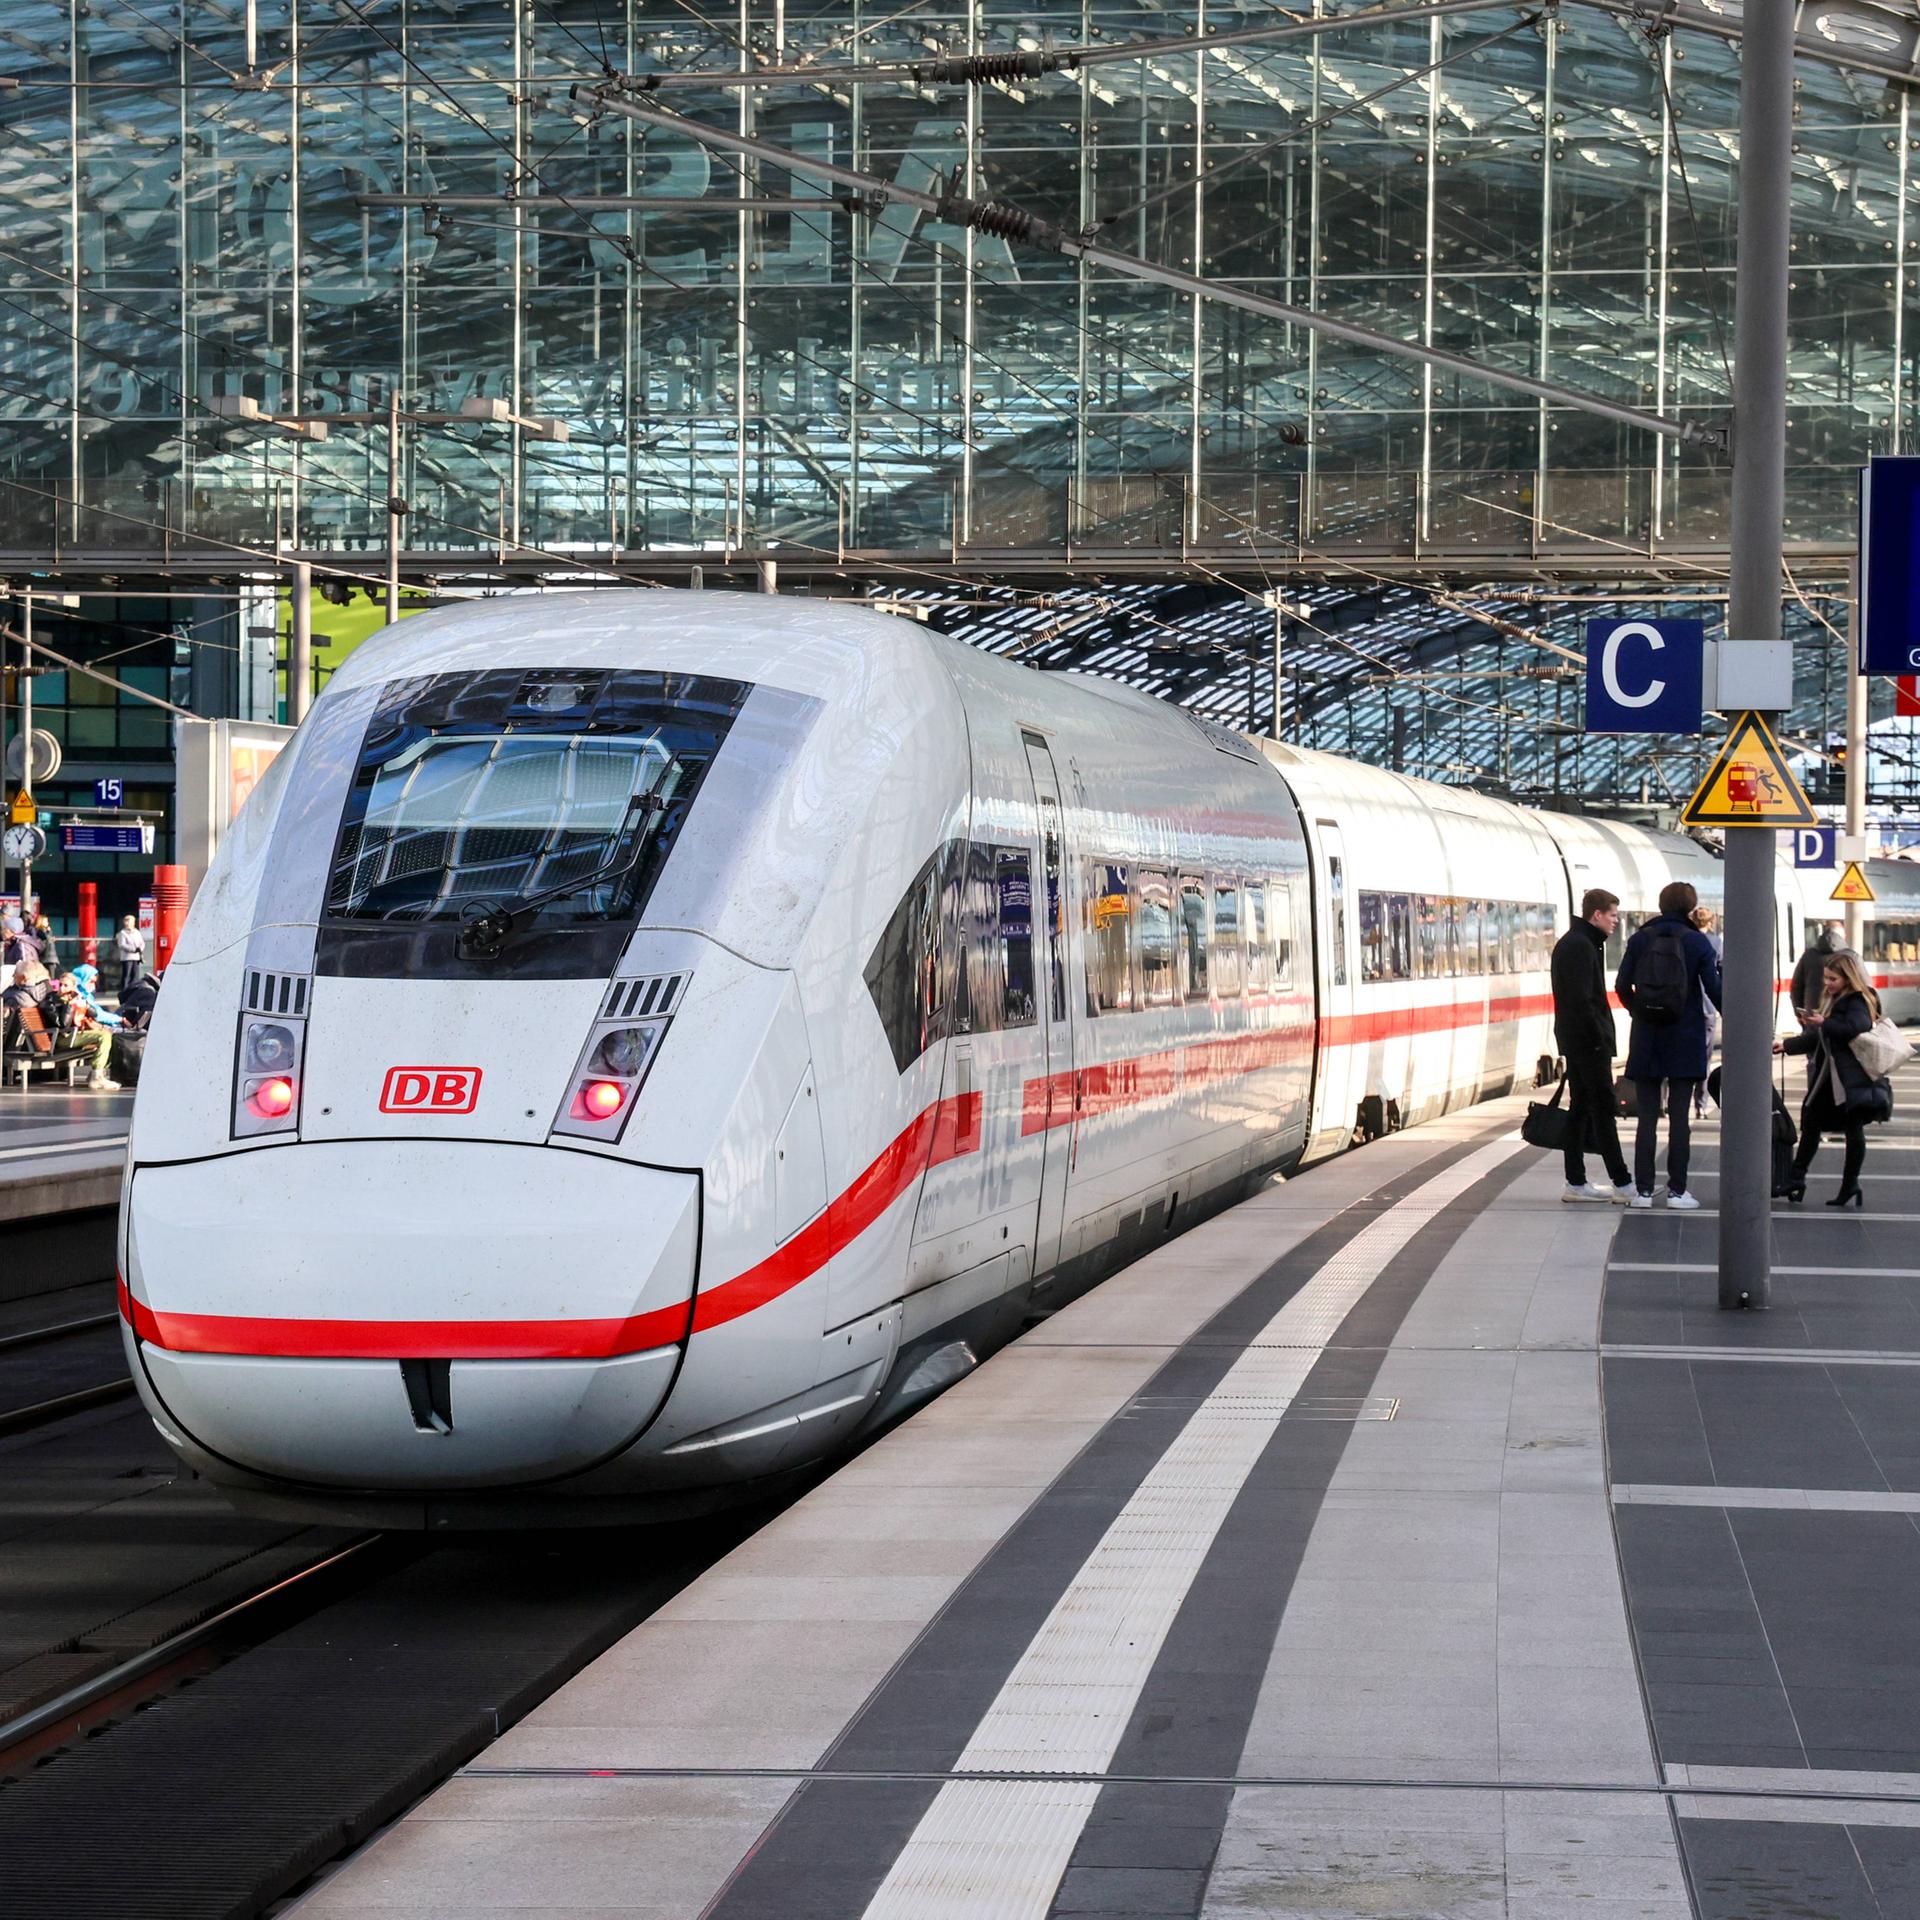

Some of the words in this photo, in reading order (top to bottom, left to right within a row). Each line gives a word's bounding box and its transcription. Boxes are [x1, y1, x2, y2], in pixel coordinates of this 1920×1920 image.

[1602, 621, 1666, 709] C
[97, 778, 121, 801] 15
[1798, 831, 1823, 862] D
[392, 1073, 468, 1106] DB
